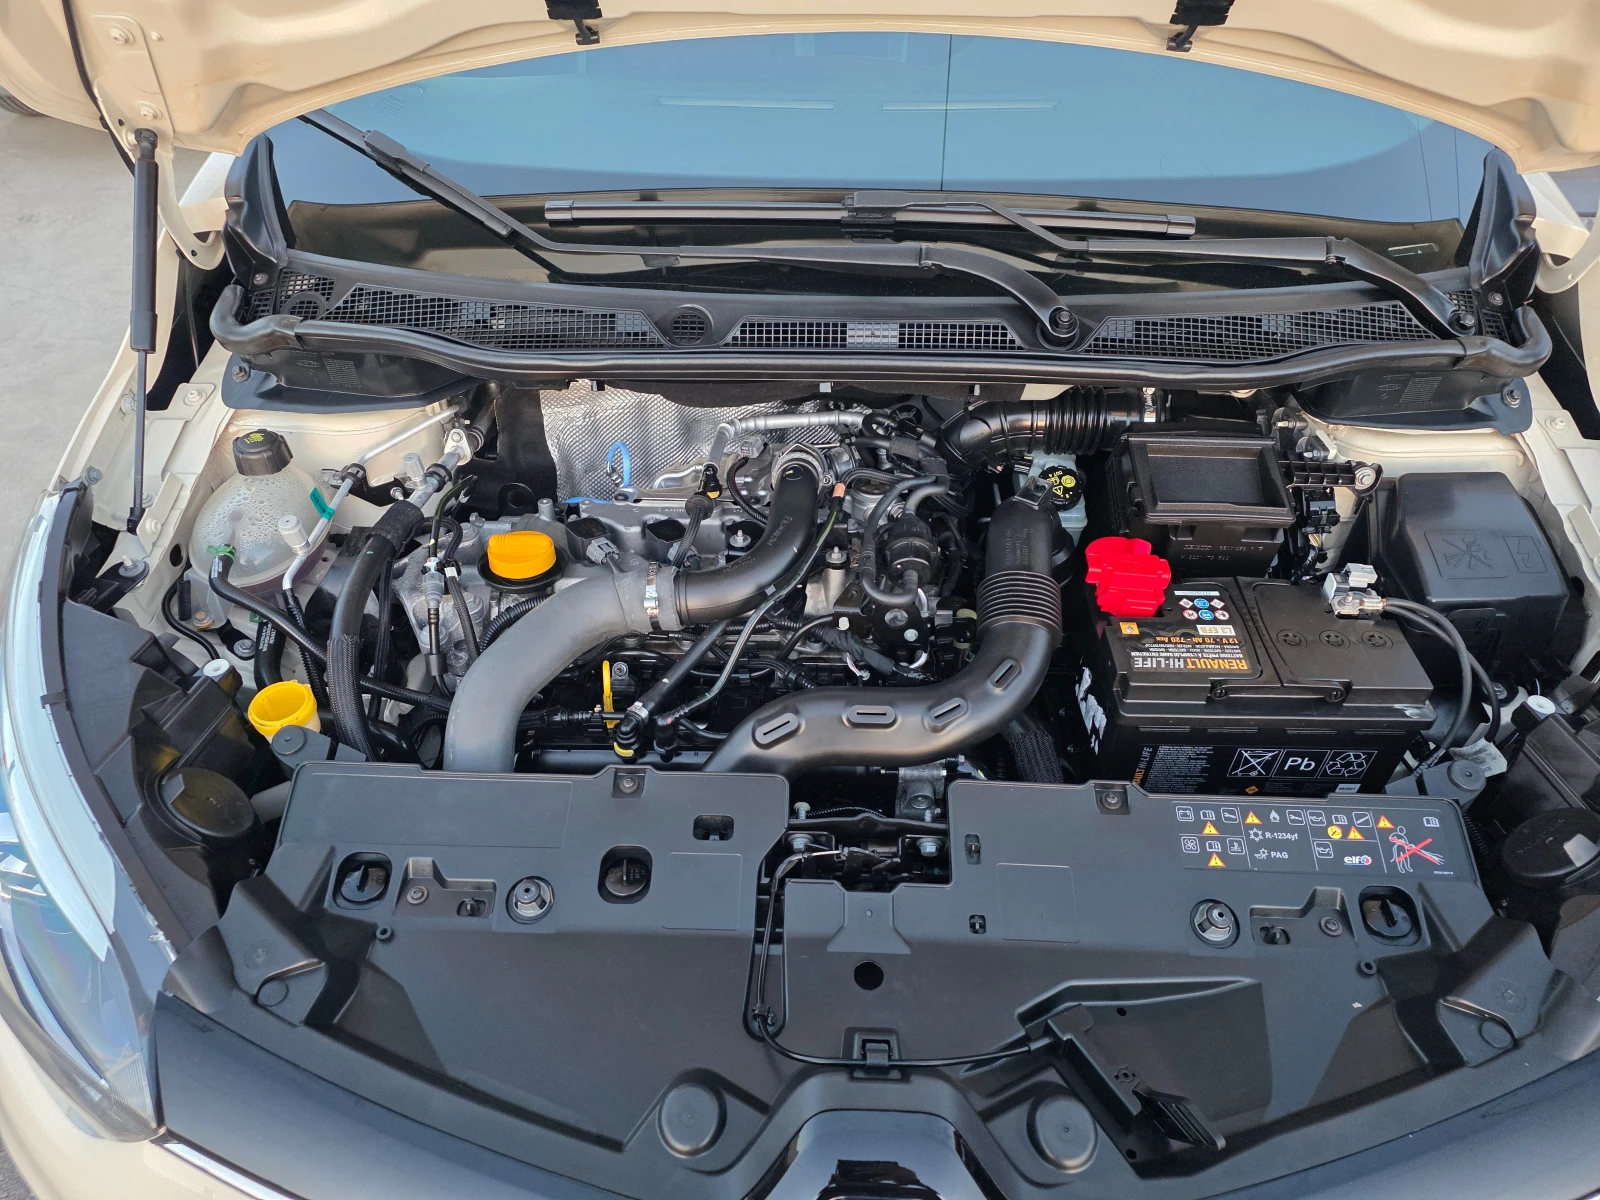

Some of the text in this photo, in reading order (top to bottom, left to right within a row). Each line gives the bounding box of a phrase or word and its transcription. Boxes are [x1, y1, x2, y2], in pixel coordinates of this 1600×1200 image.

[1187, 658, 1248, 669] RENAULT
[1283, 757, 1316, 771] Pb
[1265, 831, 1299, 841] R-1234yf
[1270, 851, 1289, 859] PAG
[1343, 855, 1361, 865] elf
